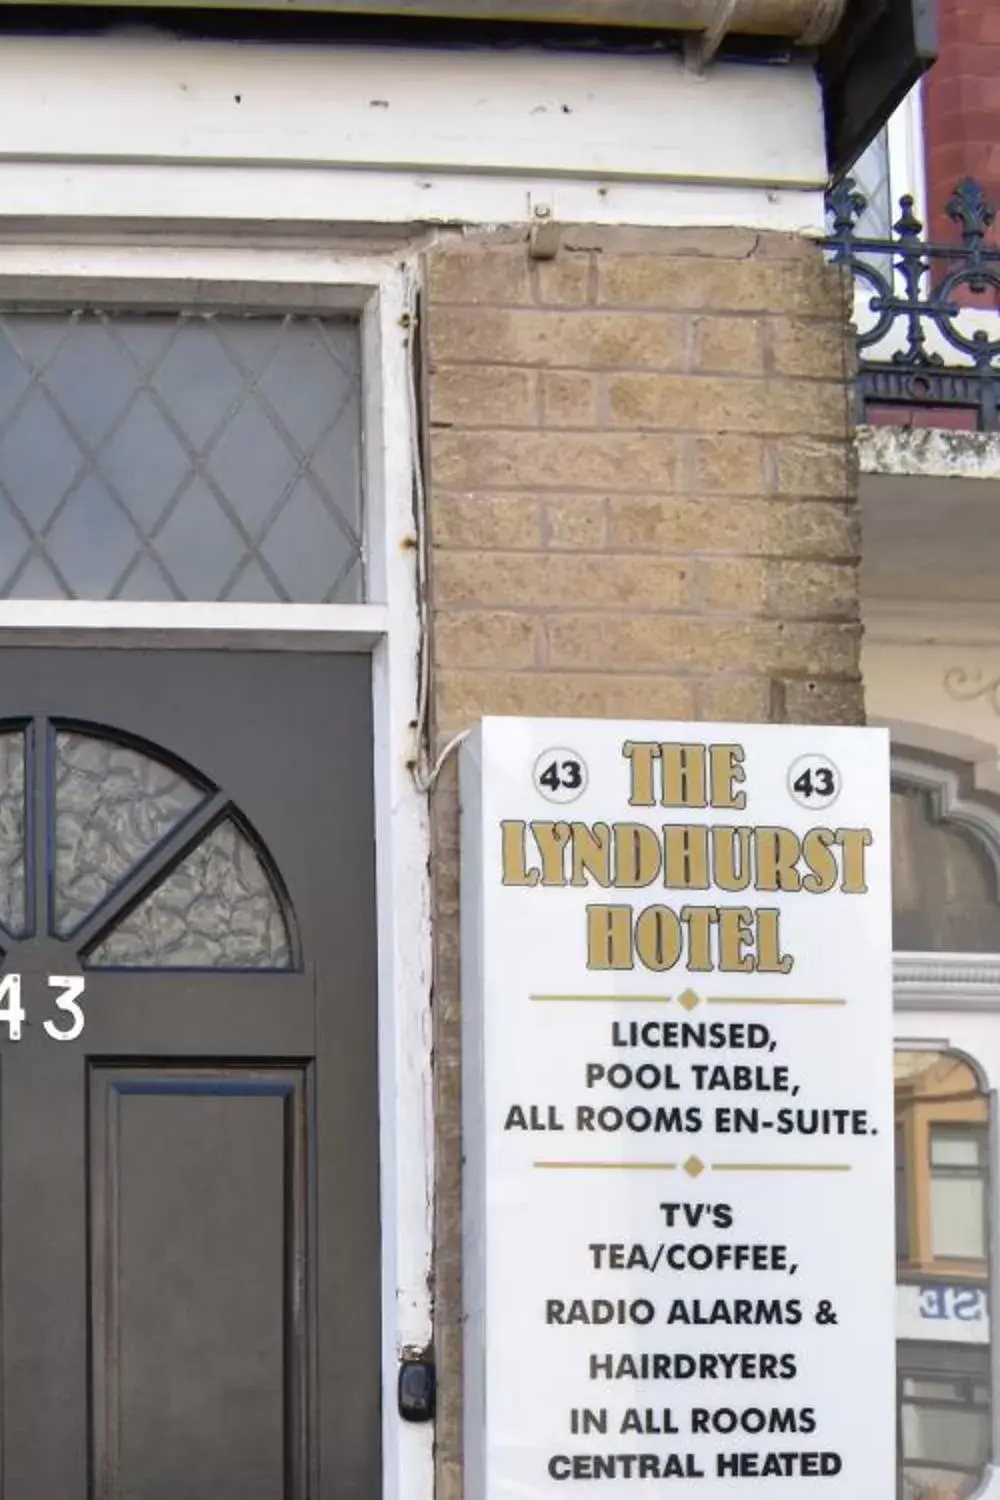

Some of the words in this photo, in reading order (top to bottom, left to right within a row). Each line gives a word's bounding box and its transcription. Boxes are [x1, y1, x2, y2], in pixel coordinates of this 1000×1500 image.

[539, 761, 582, 791] 43
[622, 740, 747, 809] THE
[793, 767, 836, 797] 43
[500, 820, 873, 893] LYNDHURST
[585, 903, 793, 974] HOTEL
[611, 1021, 778, 1052] LICENSED,
[586, 1063, 680, 1091] POOL
[691, 1065, 801, 1096] TABLE,
[504, 1105, 564, 1132] ALL
[577, 1105, 702, 1133] ROOMS
[715, 1107, 878, 1136] EN-SUITE.
[660, 1203, 733, 1229] TV'S
[589, 1243, 799, 1275] TEA/COFFEE,
[546, 1299, 655, 1326] RADIO
[667, 1299, 803, 1326] ALARMS
[815, 1300, 838, 1326] &
[589, 1353, 797, 1380] HAIRDRYERS
[571, 1408, 607, 1435] IN
[620, 1408, 679, 1435] ALL
[691, 1408, 817, 1434] ROOMS
[547, 1453, 704, 1480] CENTRAL
[716, 1452, 842, 1478] HEATED
